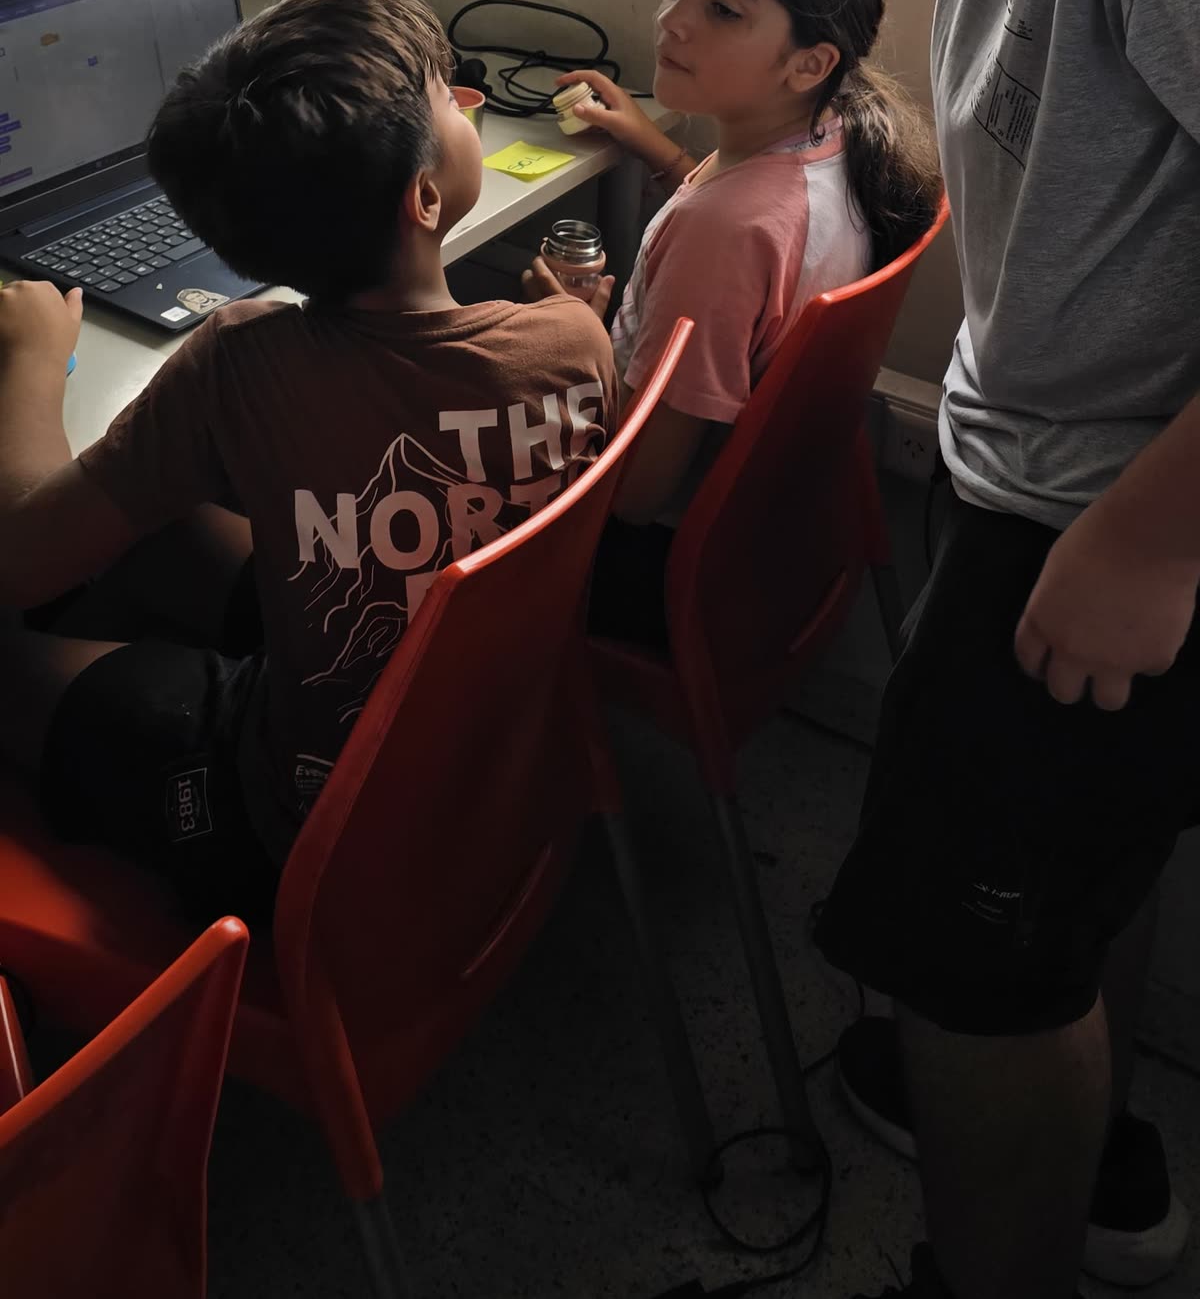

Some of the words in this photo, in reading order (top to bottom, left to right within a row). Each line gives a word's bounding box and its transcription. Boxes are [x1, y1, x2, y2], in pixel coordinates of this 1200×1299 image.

[438, 381, 603, 482] THE
[294, 469, 576, 569] NORT
[177, 779, 195, 831] 1983
